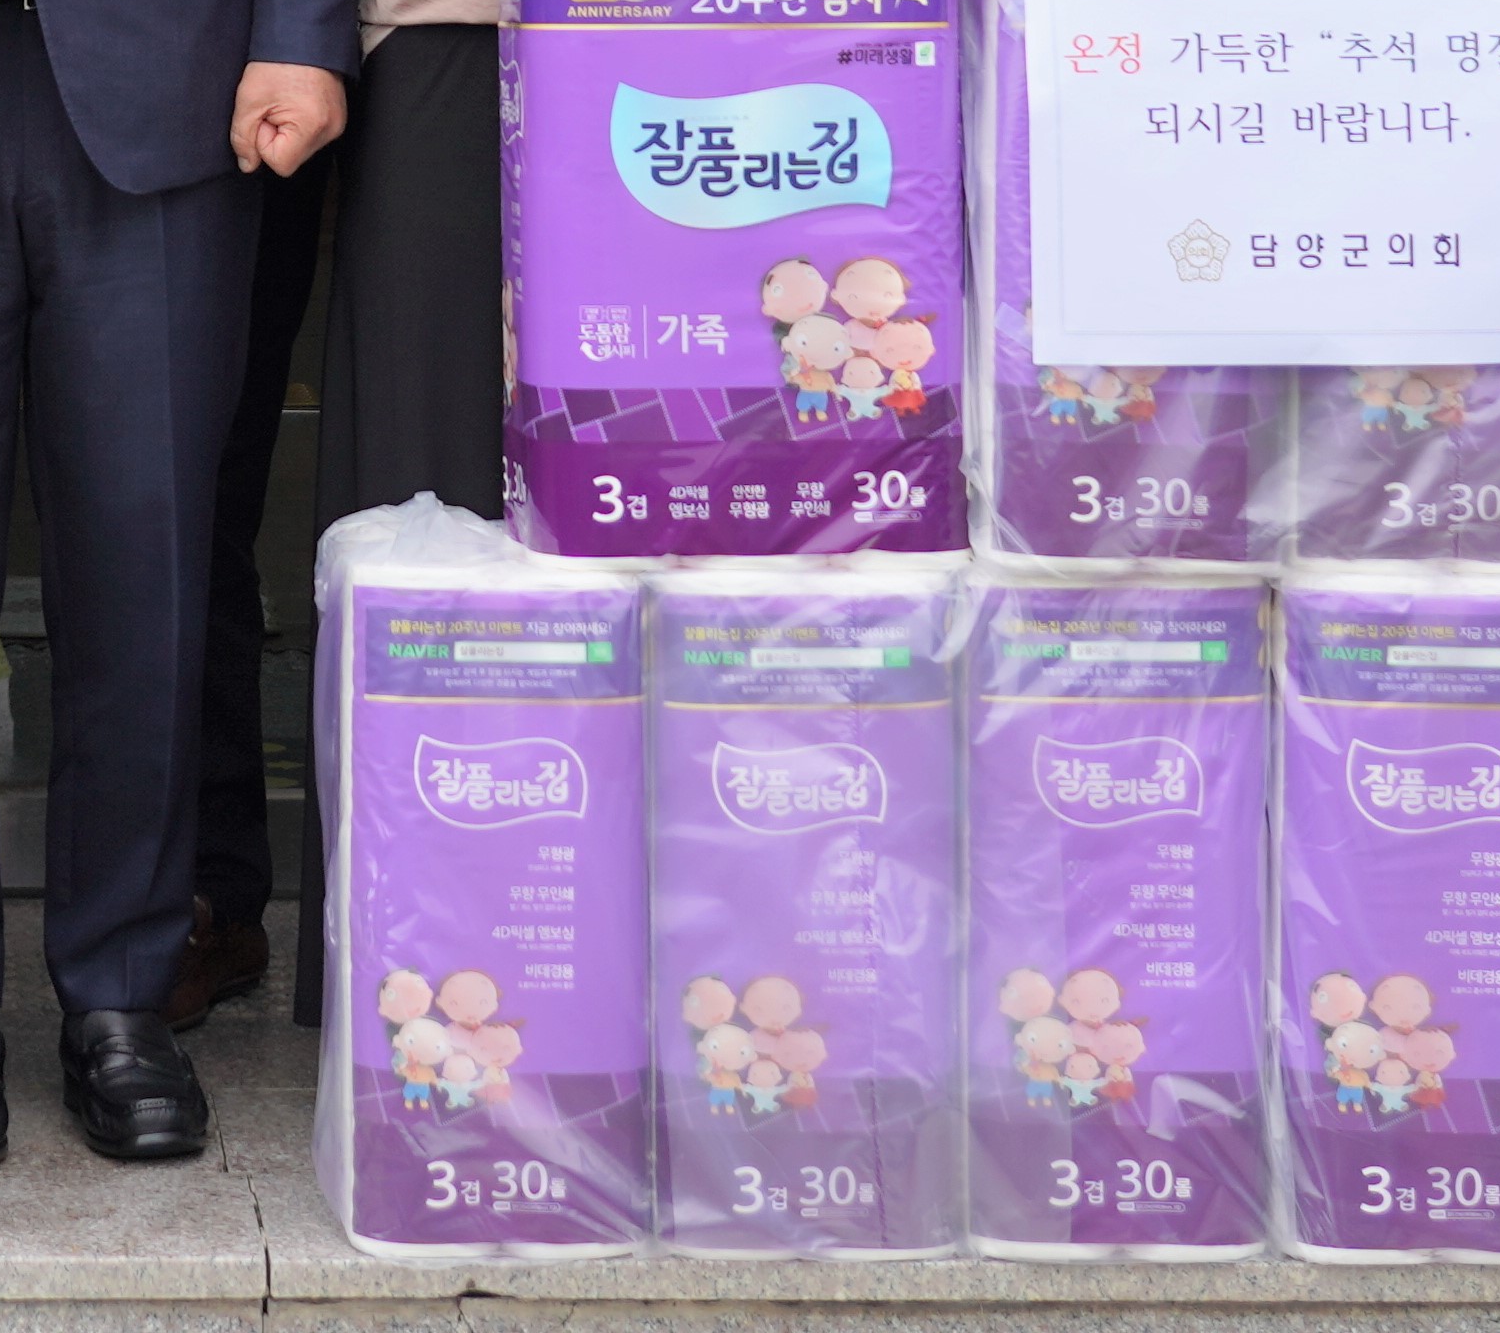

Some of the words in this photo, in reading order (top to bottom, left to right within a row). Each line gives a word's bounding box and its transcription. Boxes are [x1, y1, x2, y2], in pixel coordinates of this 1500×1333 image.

[567, 6, 673, 18] ANNIVERSARY
[1065, 32, 1143, 76] 온정
[1169, 31, 1294, 76] 가득한
[1145, 101, 1266, 145] 되시길
[1293, 101, 1474, 144] 바랍니다.
[633, 117, 859, 198] 잘풀리는집
[578, 323, 631, 344] 도톰함
[656, 314, 729, 355] 가족
[668, 502, 710, 519] 엠보싱
[729, 501, 770, 518] 무형광
[731, 484, 766, 499] 안전한
[790, 500, 831, 517] 무인쇄
[796, 482, 824, 499] 무향
[427, 758, 568, 809] 잘풀리는집
[725, 764, 868, 817] 잘풀리는집
[1047, 757, 1186, 807] 잘풀리는집
[1361, 764, 1500, 815] 잘풀리는집
